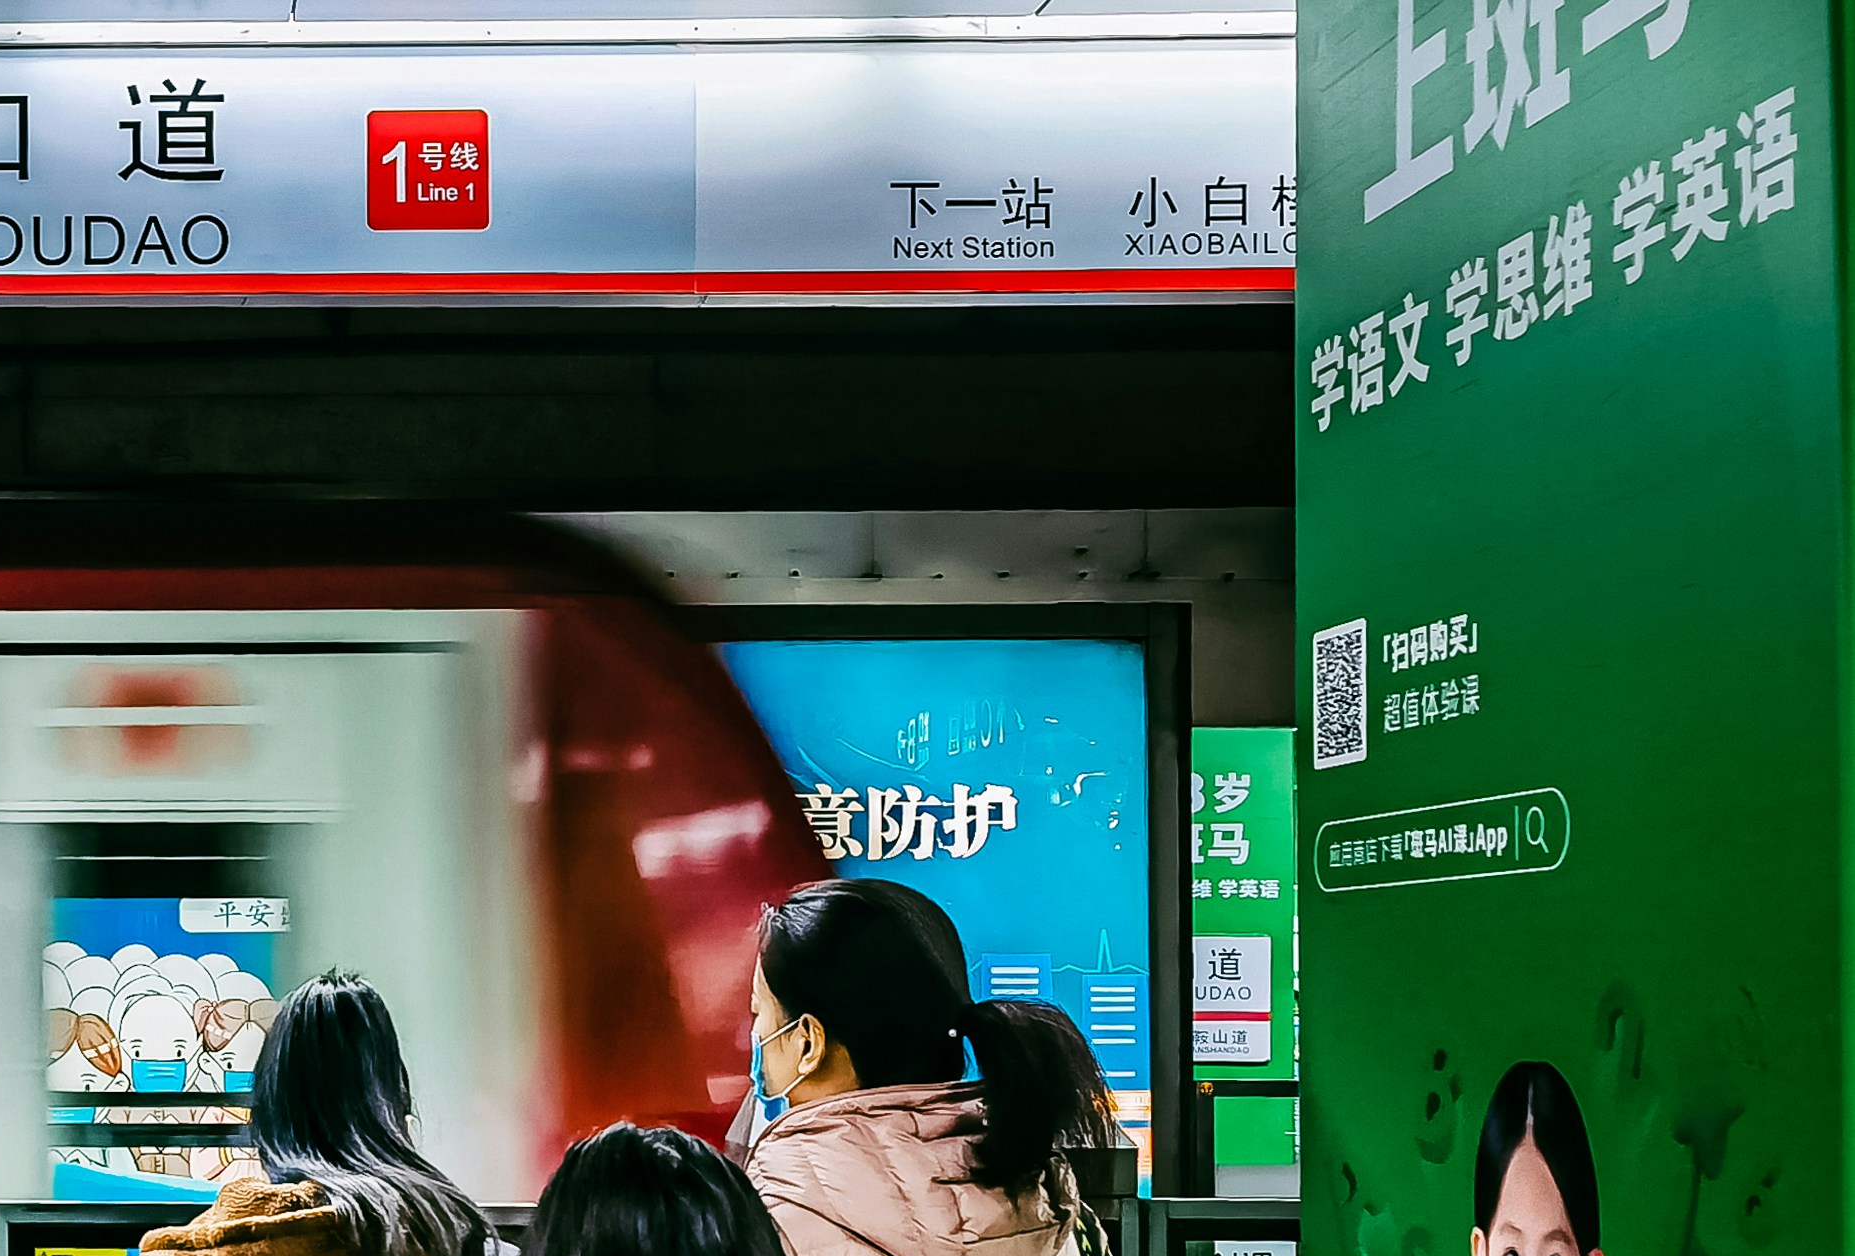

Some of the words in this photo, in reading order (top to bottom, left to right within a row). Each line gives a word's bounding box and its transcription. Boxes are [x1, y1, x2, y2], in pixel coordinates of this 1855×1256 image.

[417, 182, 458, 201] Line
[465, 182, 474, 201] 1
[890, 177, 1055, 229] 下一站
[893, 237, 954, 258] Next
[962, 236, 1055, 258] Station
[1311, 293, 1430, 432] 学语文
[1445, 200, 1593, 367] 学思维
[1613, 87, 1798, 285] 学英语
[1383, 674, 1480, 733] 超值体验课
[1218, 879, 1280, 899] 学英语
[1208, 948, 1242, 980] 道
